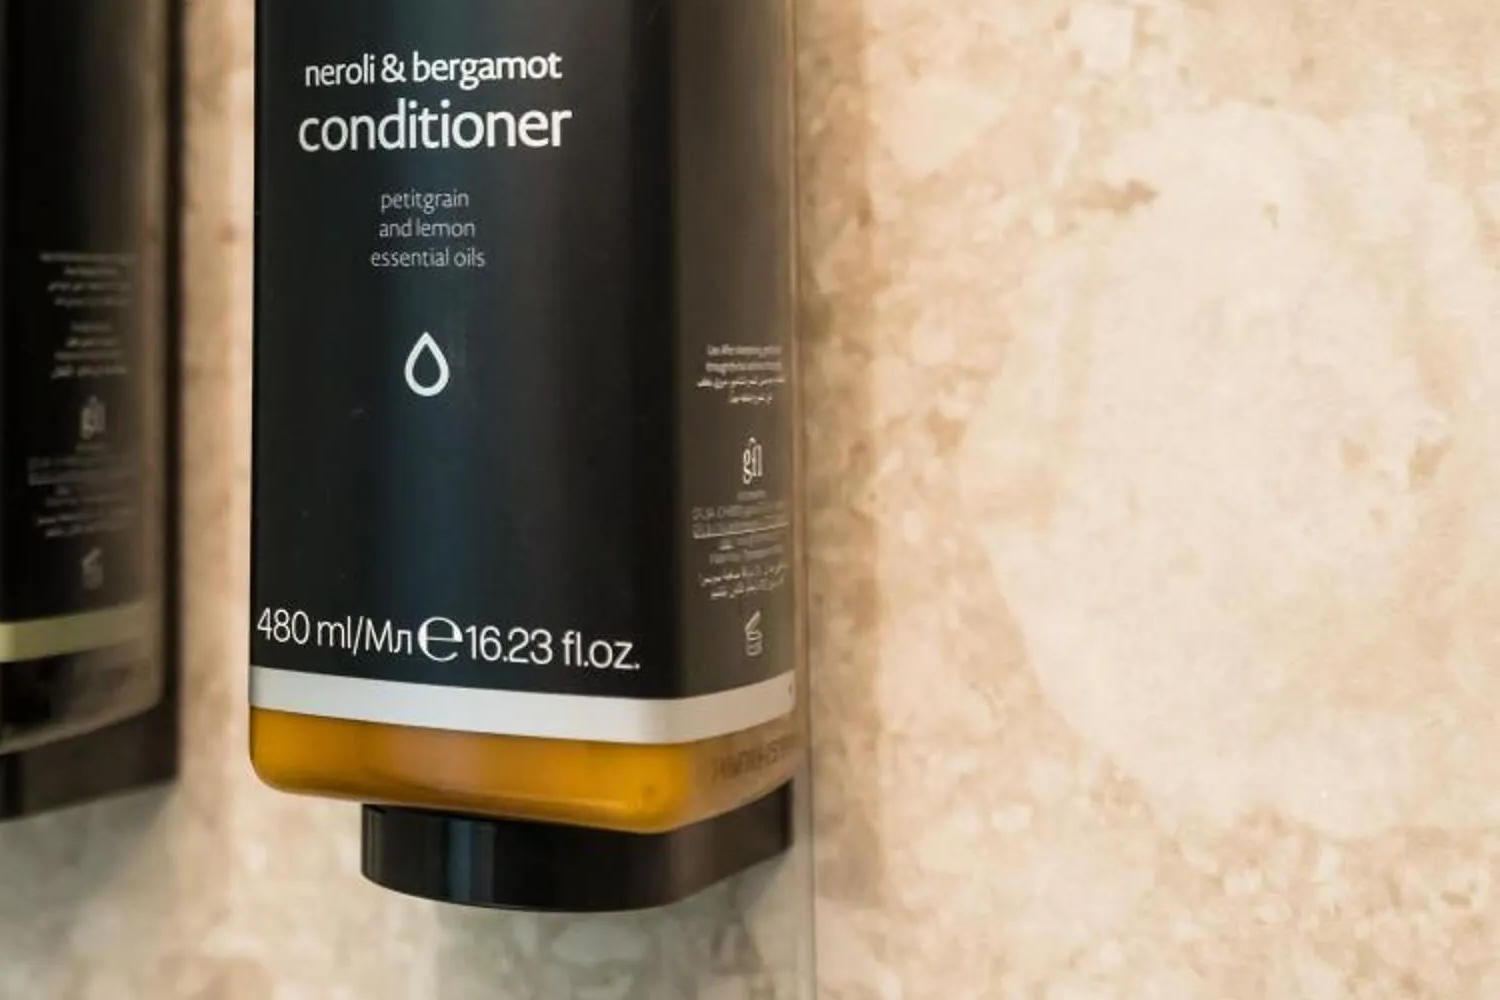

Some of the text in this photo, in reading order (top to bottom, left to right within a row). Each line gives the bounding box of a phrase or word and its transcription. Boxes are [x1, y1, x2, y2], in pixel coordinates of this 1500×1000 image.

[304, 50, 563, 90] neroli & bergamot
[298, 97, 573, 151] conditioner
[380, 188, 470, 215] petitgrain
[378, 218, 476, 238] and lemon
[370, 248, 486, 268] essential oils
[257, 606, 311, 645] 480
[465, 625, 553, 666] 16.23
